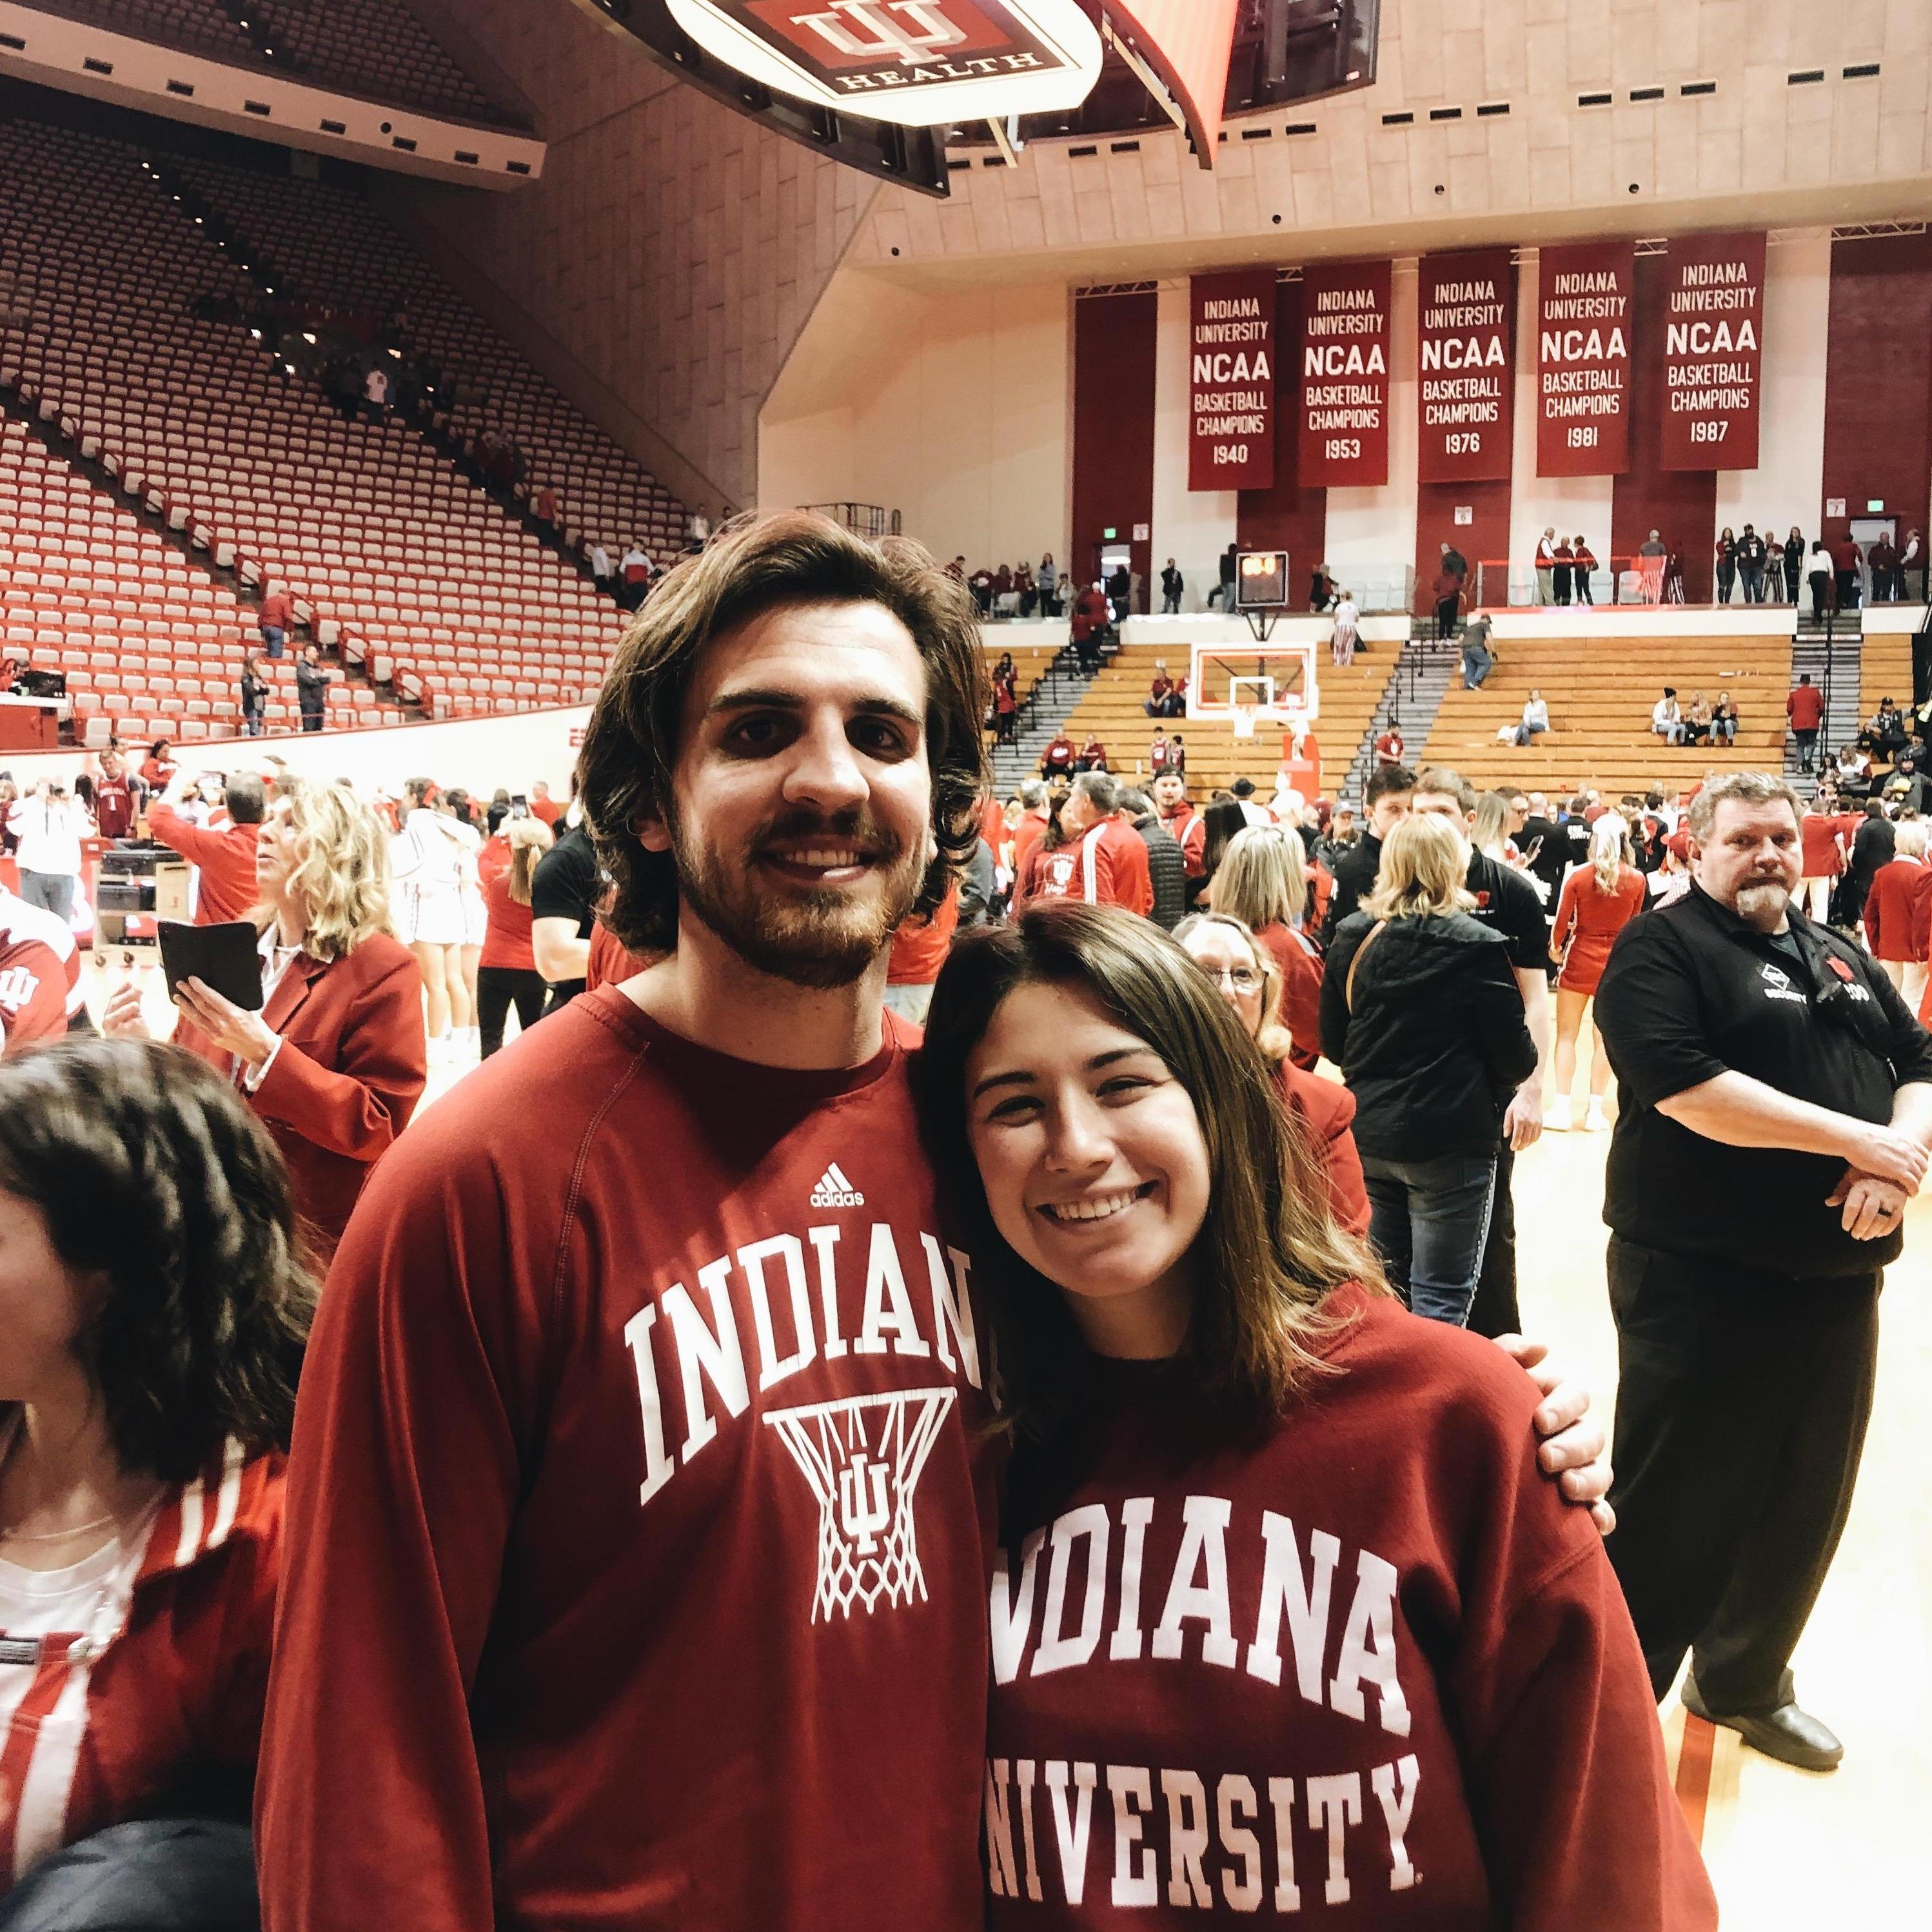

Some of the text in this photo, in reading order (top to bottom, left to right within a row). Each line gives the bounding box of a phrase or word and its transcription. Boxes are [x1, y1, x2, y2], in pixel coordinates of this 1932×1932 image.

[789, 0, 968, 65] IU
[836, 52, 1043, 90] HEALTH
[1555, 271, 1617, 295] INDIANA
[1682, 262, 1748, 286] INDIANA
[1317, 290, 1375, 311] INDIANA
[1435, 281, 1495, 304] INDIANA
[1671, 286, 1757, 312] UNIVERSITY
[1204, 298, 1260, 319] INDIANA
[1425, 304, 1504, 329] UNIVERSITY
[1544, 296, 1627, 320] UNIVERSITY
[1196, 321, 1268, 344] UNIVERSITY
[1308, 314, 1384, 336] UNIVERSITY
[1666, 319, 1757, 355] NCAA
[1421, 335, 1505, 371] NCAA
[1541, 327, 1627, 362] NCAA
[1193, 351, 1270, 384] NCAA
[1305, 344, 1386, 377] NCAA
[1543, 368, 1624, 393] BASKETBALL
[1668, 362, 1753, 387] BASKETBALL
[1306, 384, 1383, 406] BASKETBALL
[1423, 377, 1501, 401] BASKETBALL
[1671, 388, 1750, 412] CHAMPIONS
[1194, 391, 1267, 413] BASKETBALL
[1426, 402, 1499, 425] CHAMPIONS
[1546, 394, 1620, 418] CHAMPIONS
[1196, 415, 1264, 436] CHAMPIONS
[1308, 409, 1379, 431] CHAMPIONS
[1690, 420, 1728, 442] 1987
[1325, 439, 1361, 459] 1953
[1446, 433, 1480, 454] 1976
[1567, 426, 1598, 448] 1981
[1214, 444, 1248, 464] 1940
[810, 1190, 865, 1207] adidas
[624, 1223, 981, 1506] INDIAN
[839, 1453, 890, 1555] IU
[990, 1495, 1411, 1739] NDIANA
[986, 1753, 1420, 1913] NIVERSITY
